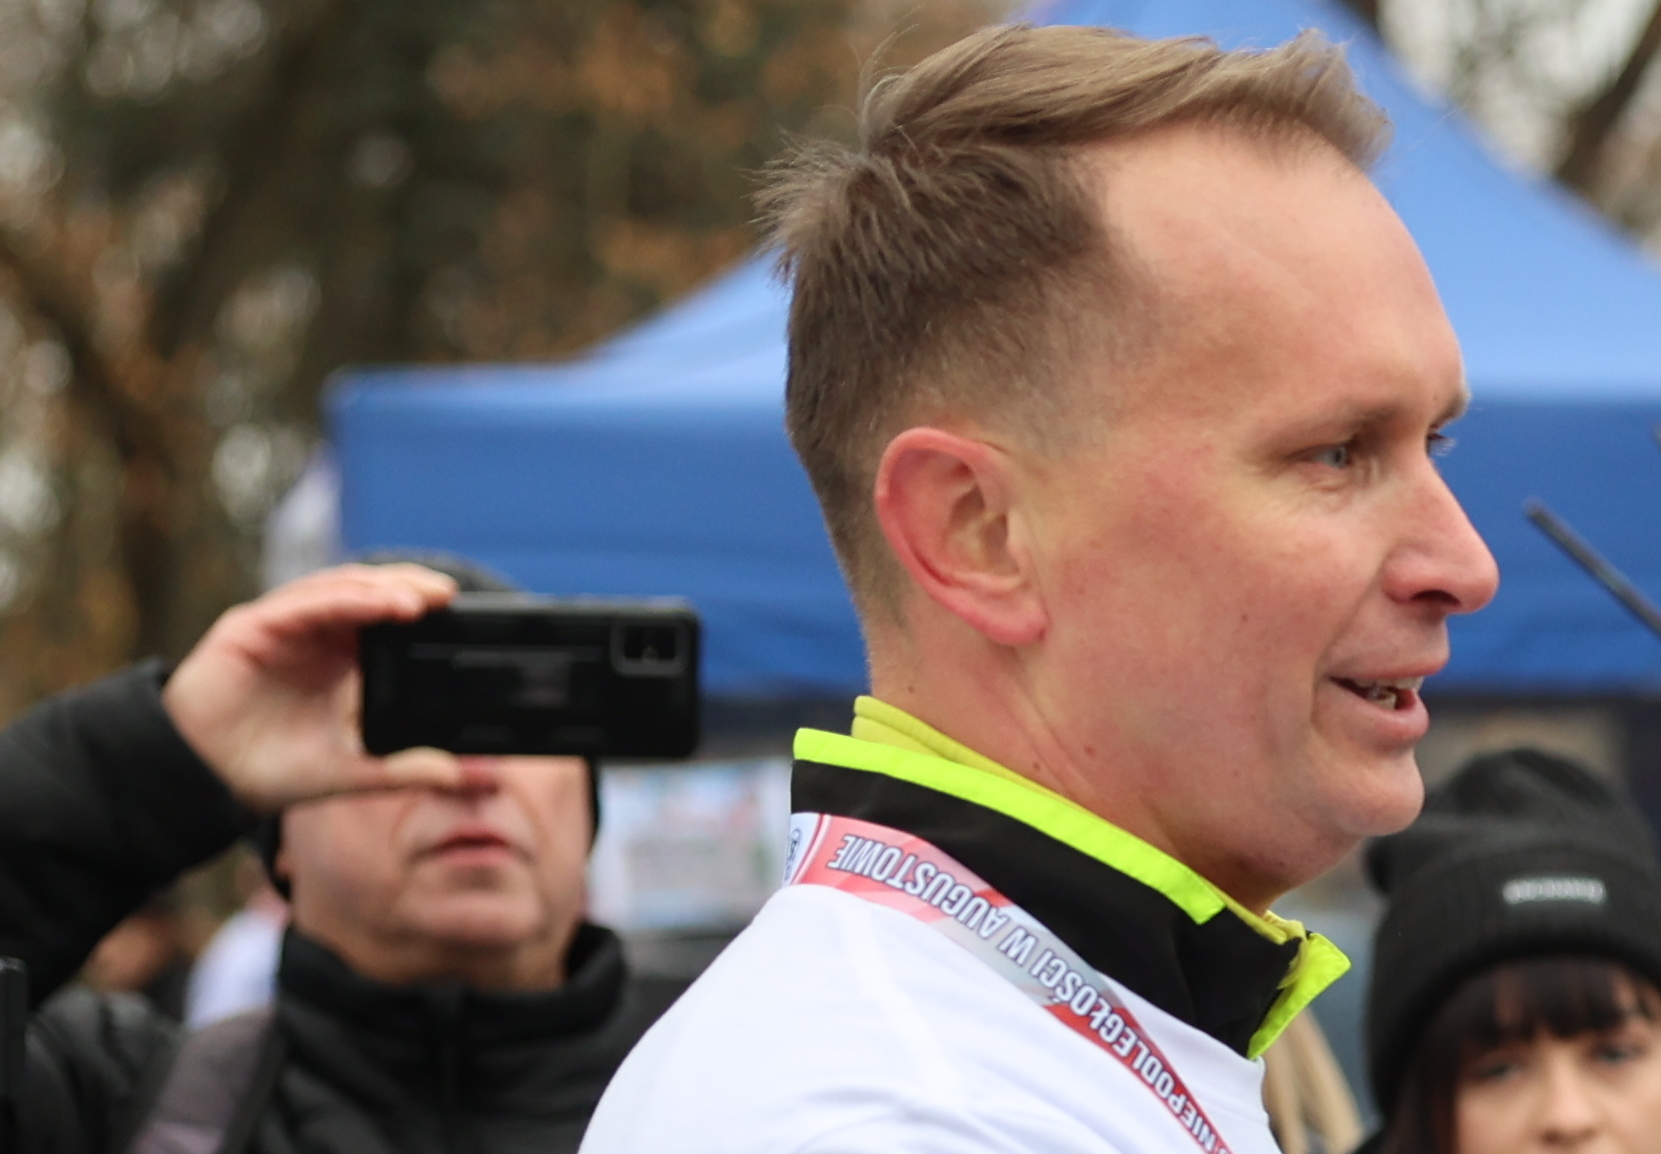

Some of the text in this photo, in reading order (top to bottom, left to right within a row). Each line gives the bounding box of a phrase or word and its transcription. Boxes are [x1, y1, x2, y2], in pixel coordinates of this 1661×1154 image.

[825, 833, 1012, 941] AUGUSTOWIE
[995, 924, 1040, 968] W
[1029, 948, 1217, 1154] NIEPODLEGŁOŚCI
